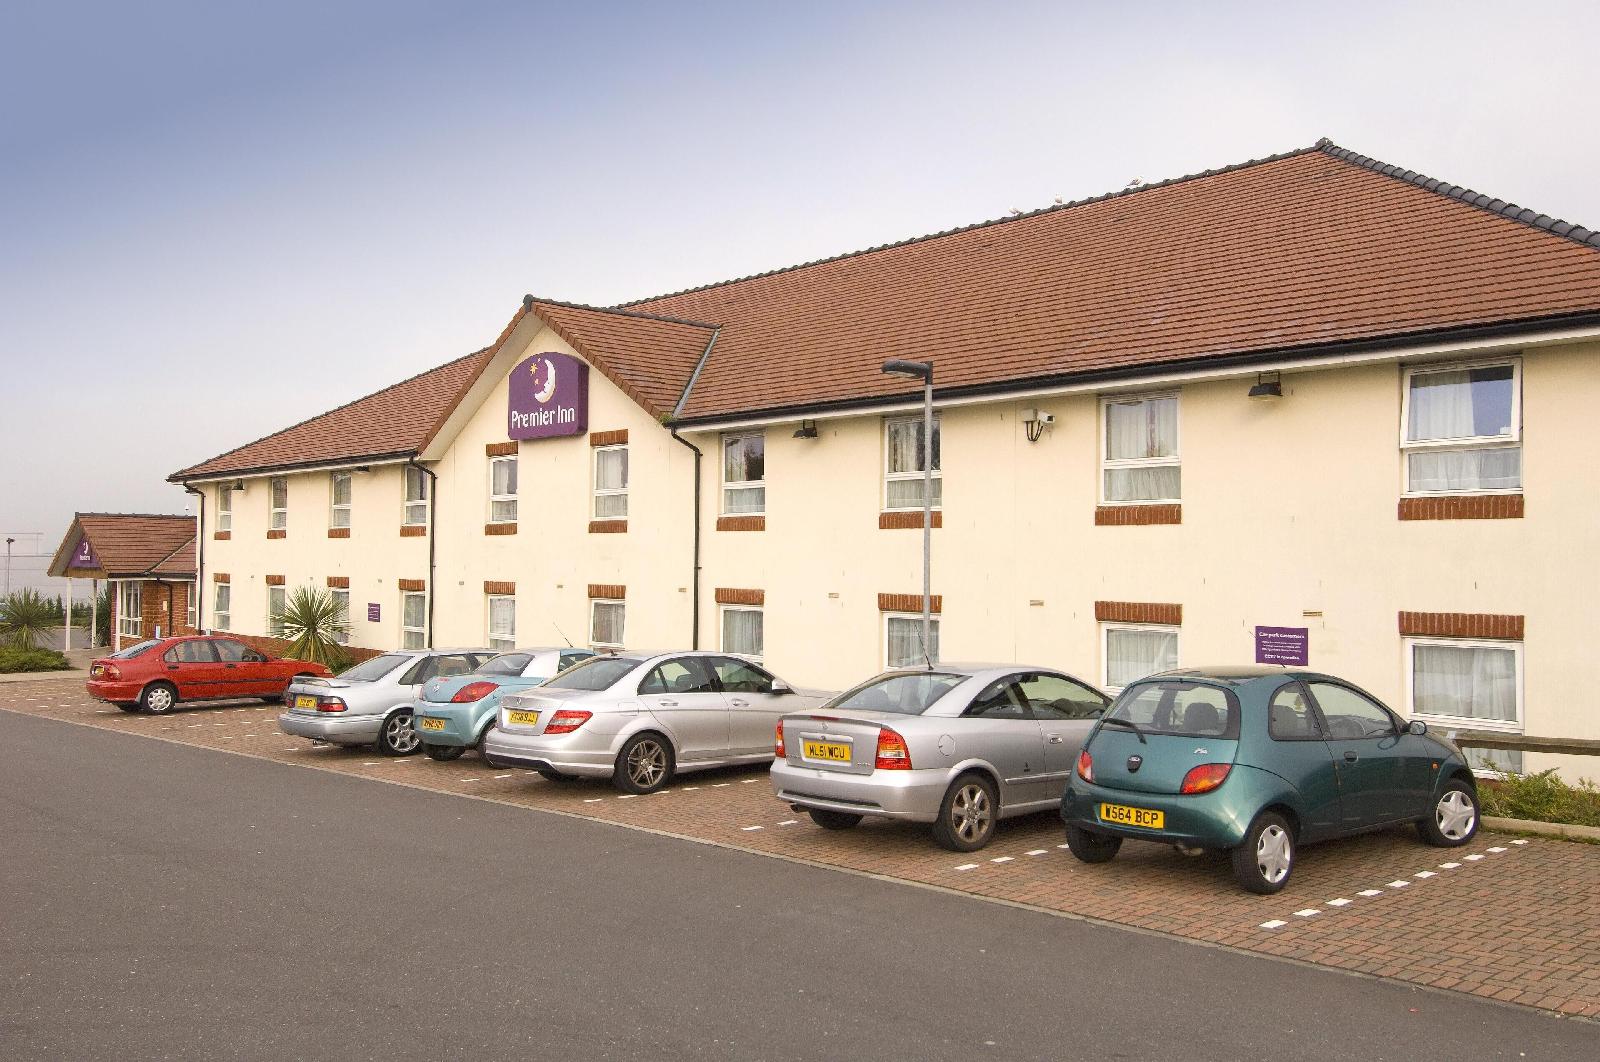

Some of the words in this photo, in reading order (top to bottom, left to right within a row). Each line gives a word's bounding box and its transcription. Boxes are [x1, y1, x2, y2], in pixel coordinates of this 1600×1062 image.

[511, 408, 555, 429] Premier
[557, 405, 575, 424] Inn
[1105, 805, 1131, 820] W564
[1135, 810, 1158, 824] BCP
